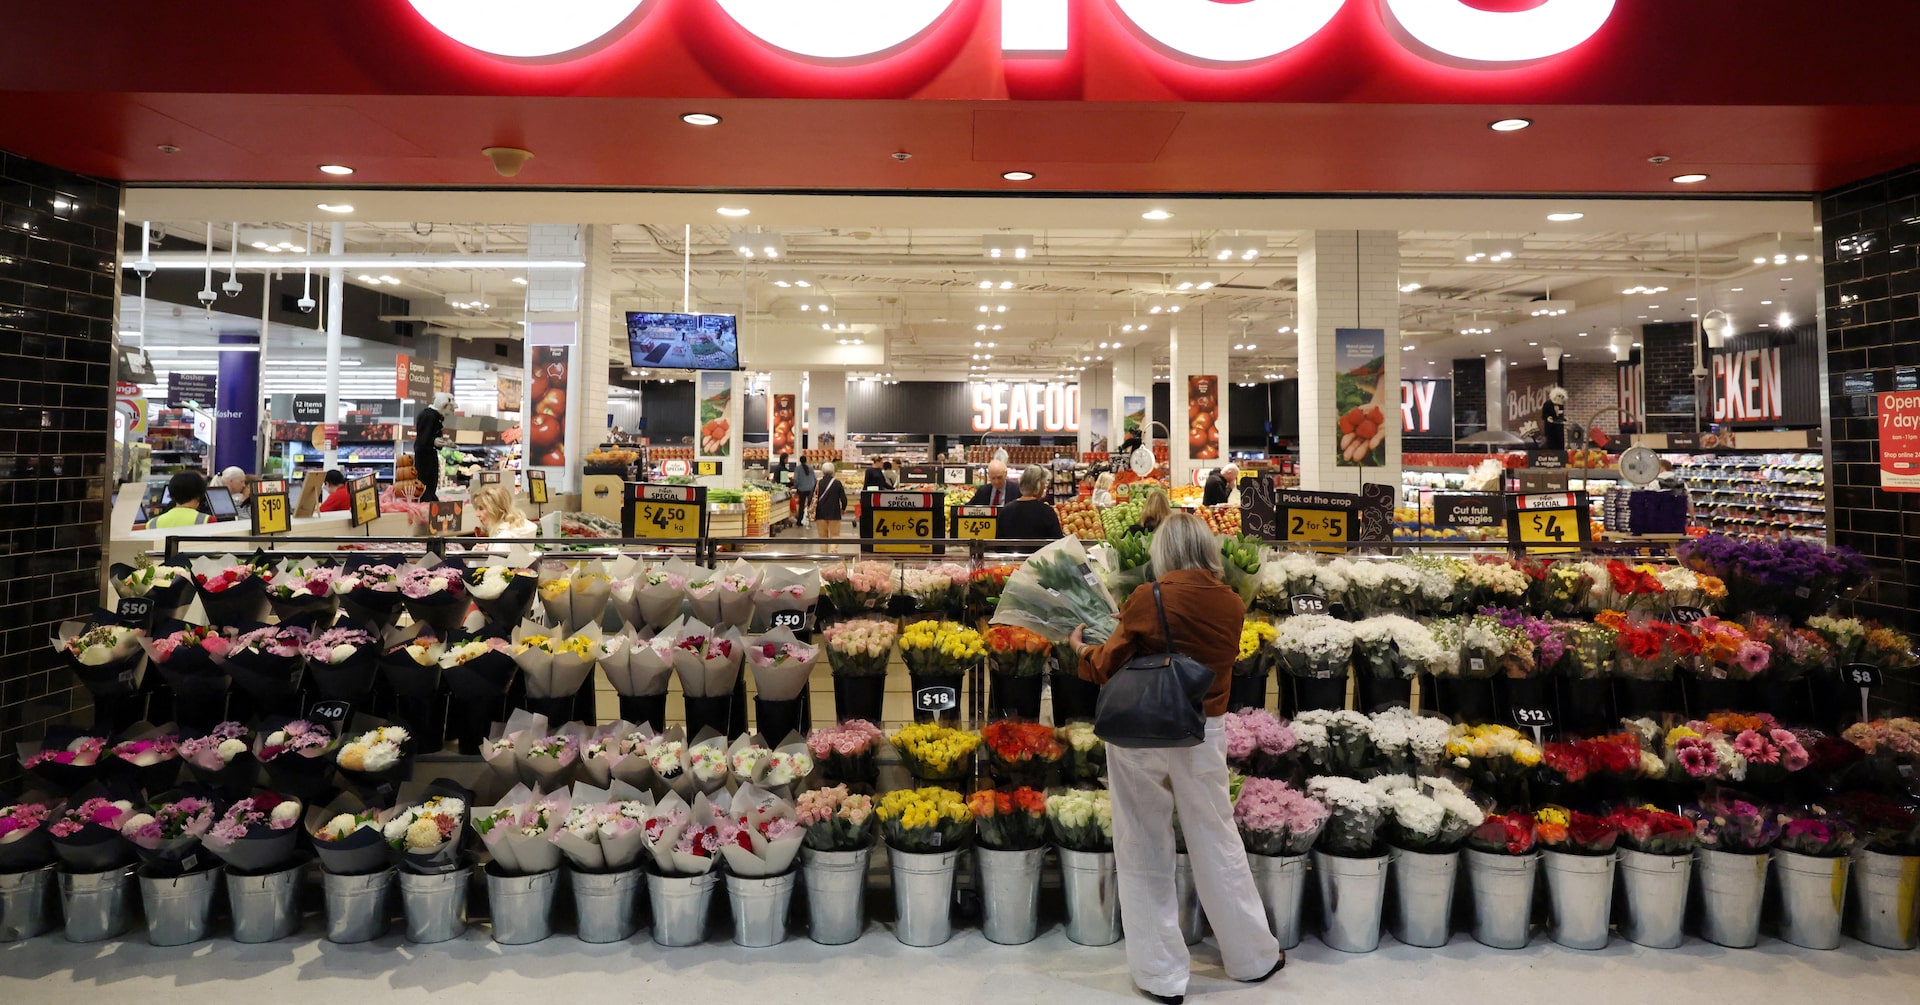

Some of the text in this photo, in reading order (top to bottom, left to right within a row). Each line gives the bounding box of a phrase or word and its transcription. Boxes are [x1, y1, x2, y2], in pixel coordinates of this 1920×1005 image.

[180, 373, 205, 381] Kosher
[116, 386, 138, 395] ings
[1712, 347, 1782, 423] CKEN
[1507, 383, 1558, 421] Baker
[1618, 365, 1642, 426] HO
[973, 384, 1079, 432] SEAFOO
[1400, 380, 1436, 432] RY
[1884, 394, 1920, 412] Open
[1882, 412, 1920, 430] 7 day
[1883, 451, 1897, 459] Shop
[1282, 494, 1352, 507] Pick of the crop
[1452, 506, 1489, 514] Cut fruit
[1291, 516, 1342, 537] 2 for $5
[1448, 514, 1493, 525] & veggies
[674, 523, 684, 533] kg
[875, 517, 929, 537] 4 for $6
[1533, 514, 1565, 542] $4
[120, 602, 148, 615] $50
[1298, 598, 1323, 611] $15
[775, 614, 800, 626] $30
[1852, 669, 1872, 683] $8
[922, 692, 949, 706] $18
[1518, 708, 1545, 721] $12
